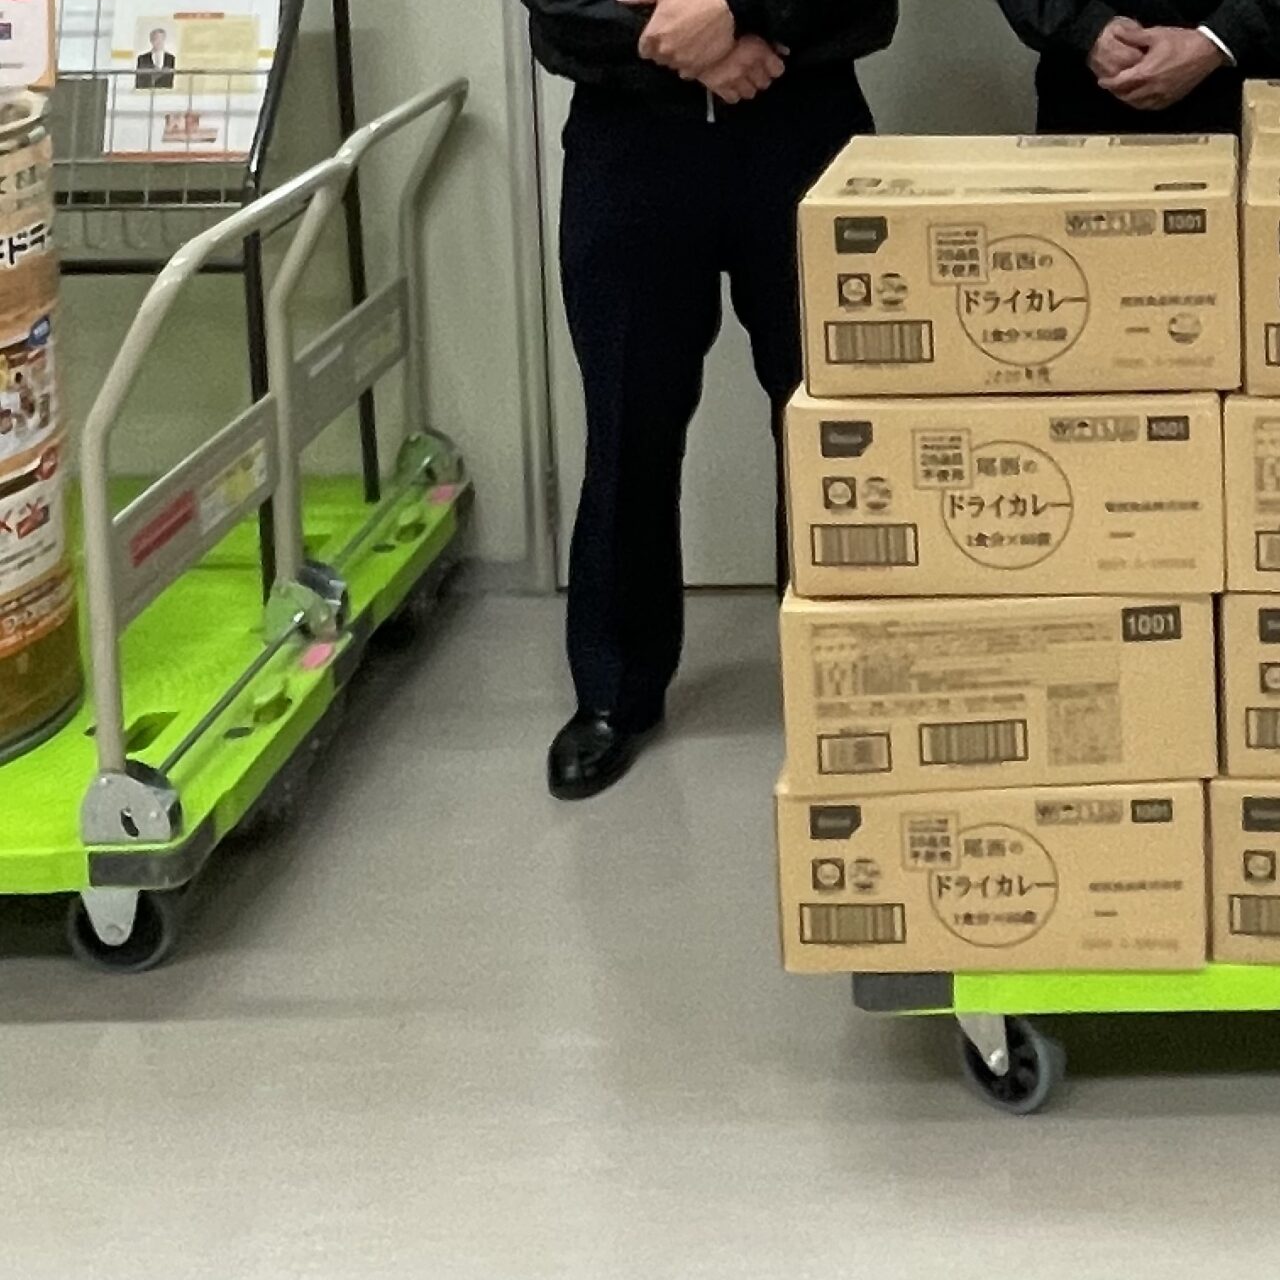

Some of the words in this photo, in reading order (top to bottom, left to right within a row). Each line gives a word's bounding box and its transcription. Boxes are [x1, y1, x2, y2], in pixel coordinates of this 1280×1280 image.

[964, 287, 1087, 315] ドライカレー
[950, 493, 1072, 519] ドライカレー
[1126, 612, 1176, 636] 1001
[936, 874, 1058, 899] ドライカレー
